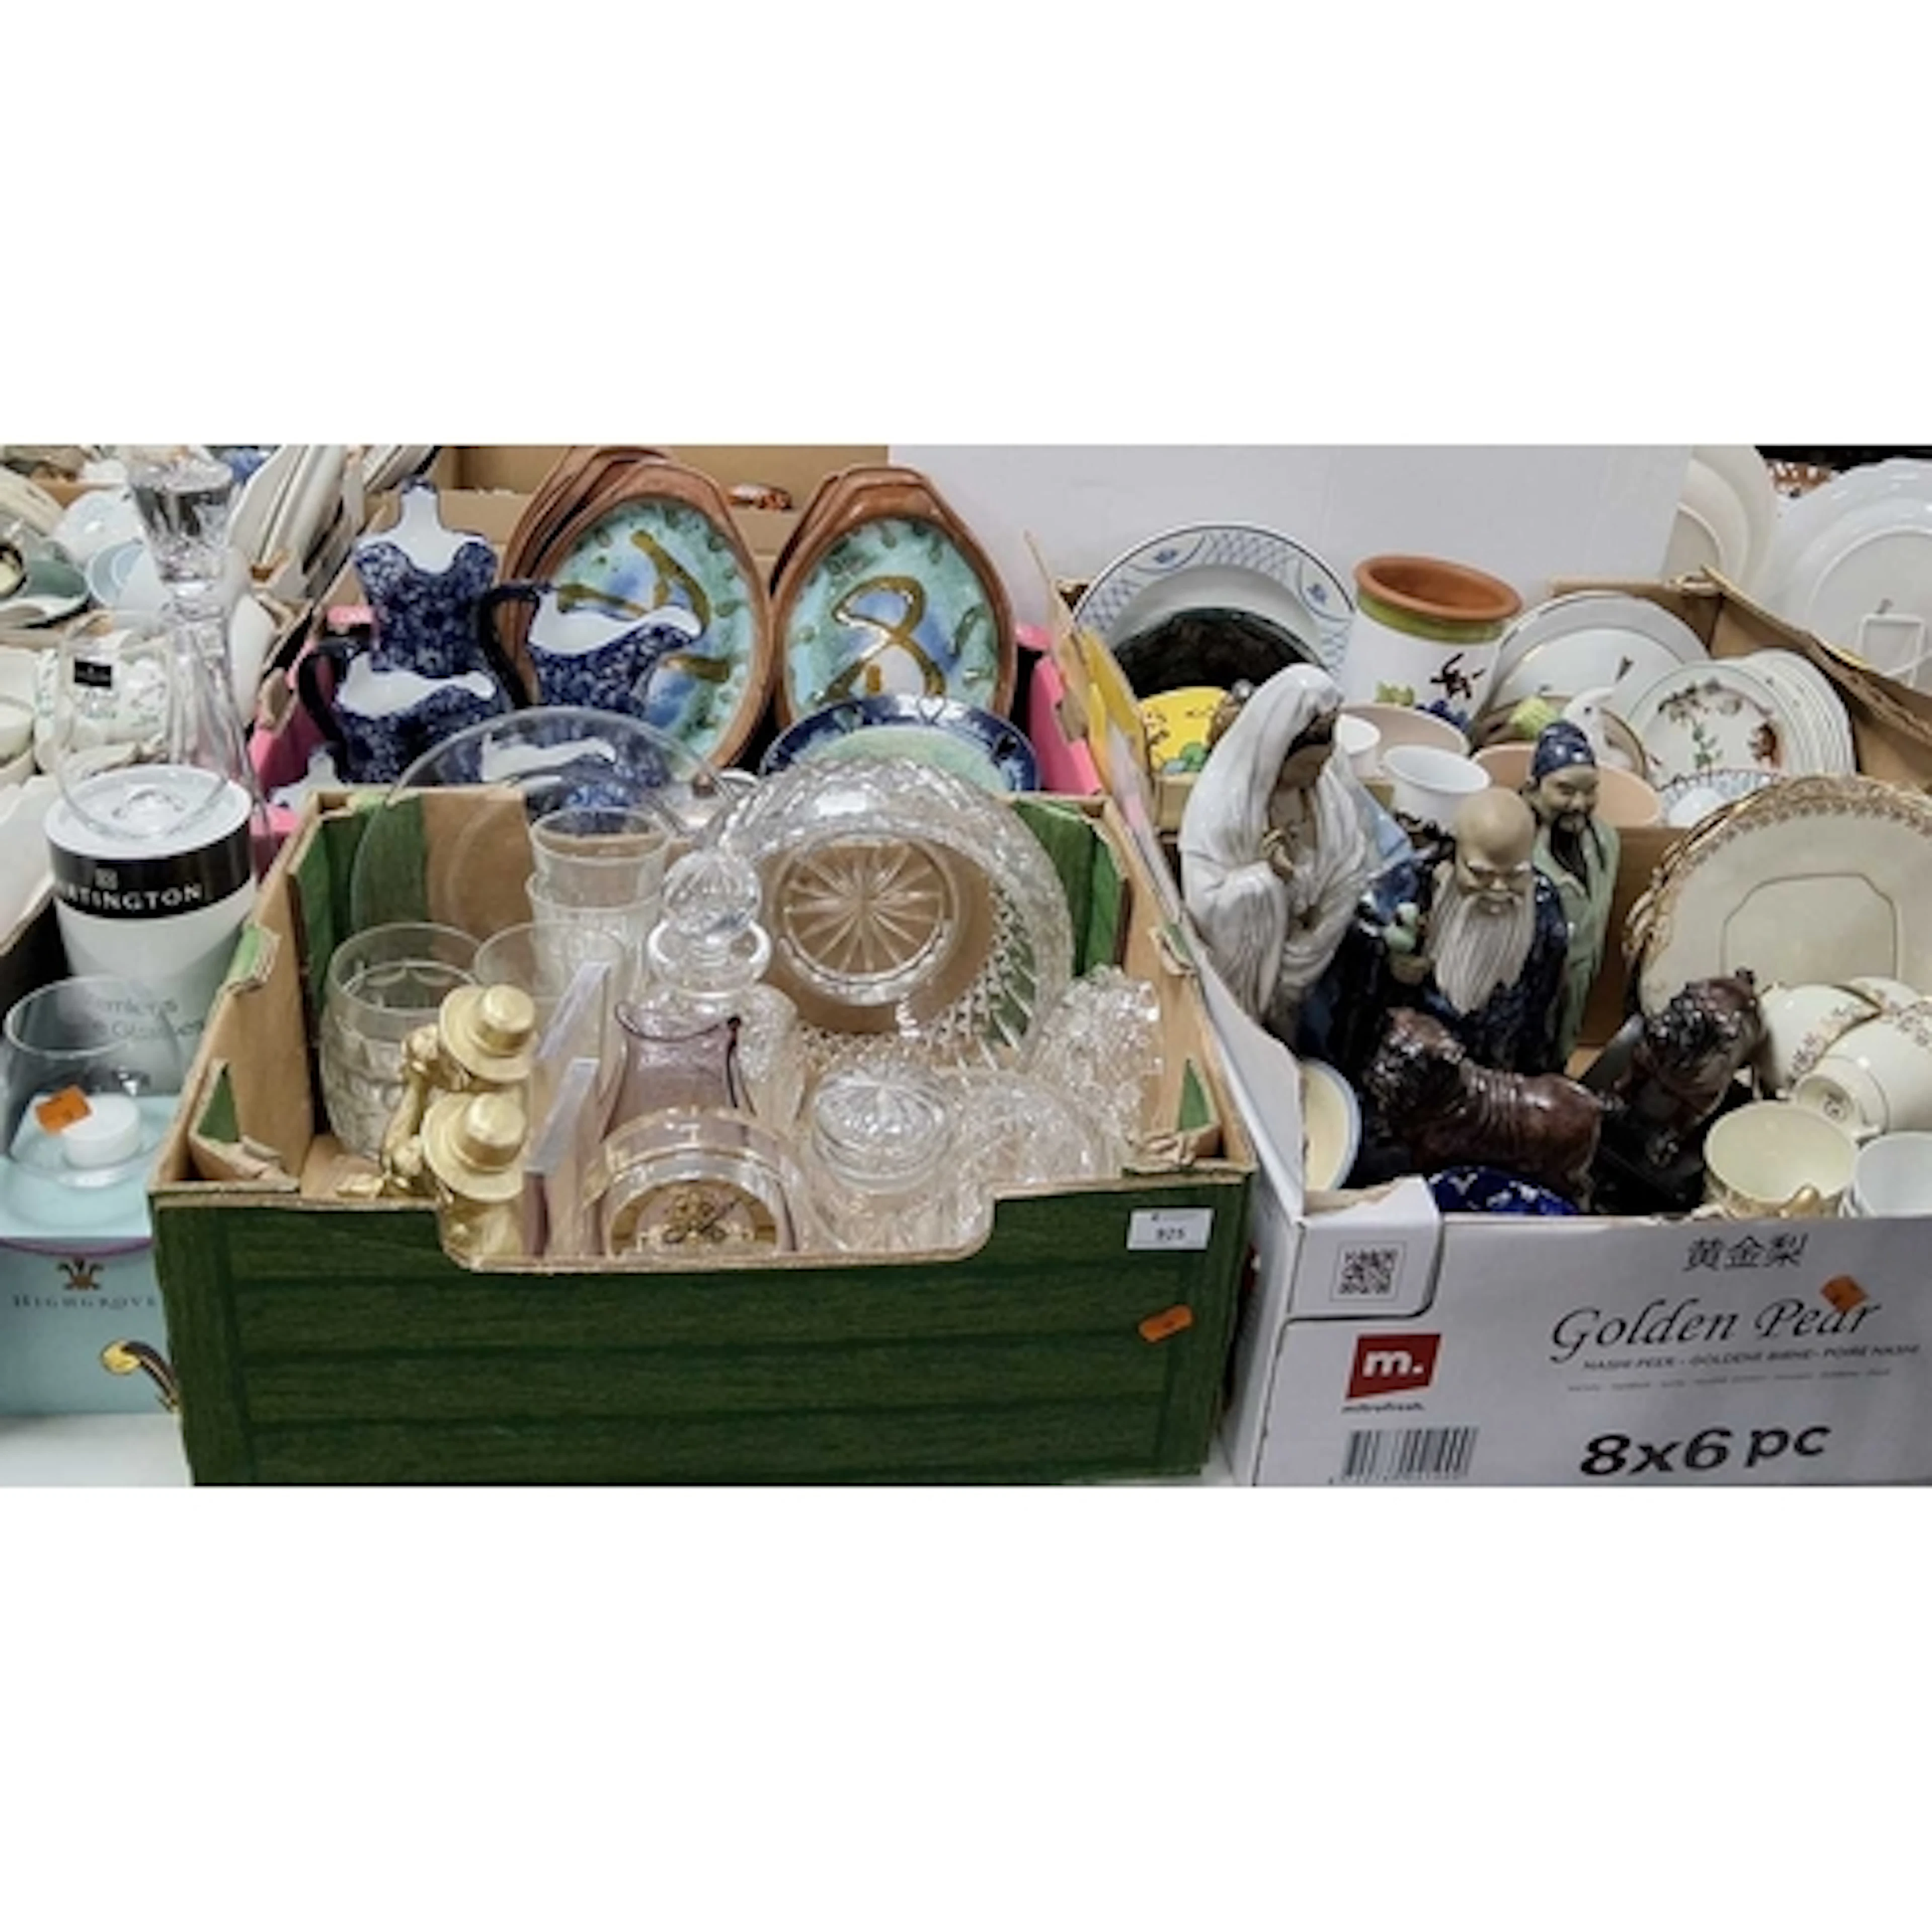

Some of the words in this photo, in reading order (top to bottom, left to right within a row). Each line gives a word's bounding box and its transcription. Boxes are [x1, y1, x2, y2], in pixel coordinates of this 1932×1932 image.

[1682, 1233, 1809, 1271] 黄金梨
[1549, 1298, 1739, 1364] Golden
[1754, 1299, 1881, 1340] Pear
[1580, 1427, 1734, 1476] 8x6
[1744, 1426, 1832, 1469] pc
